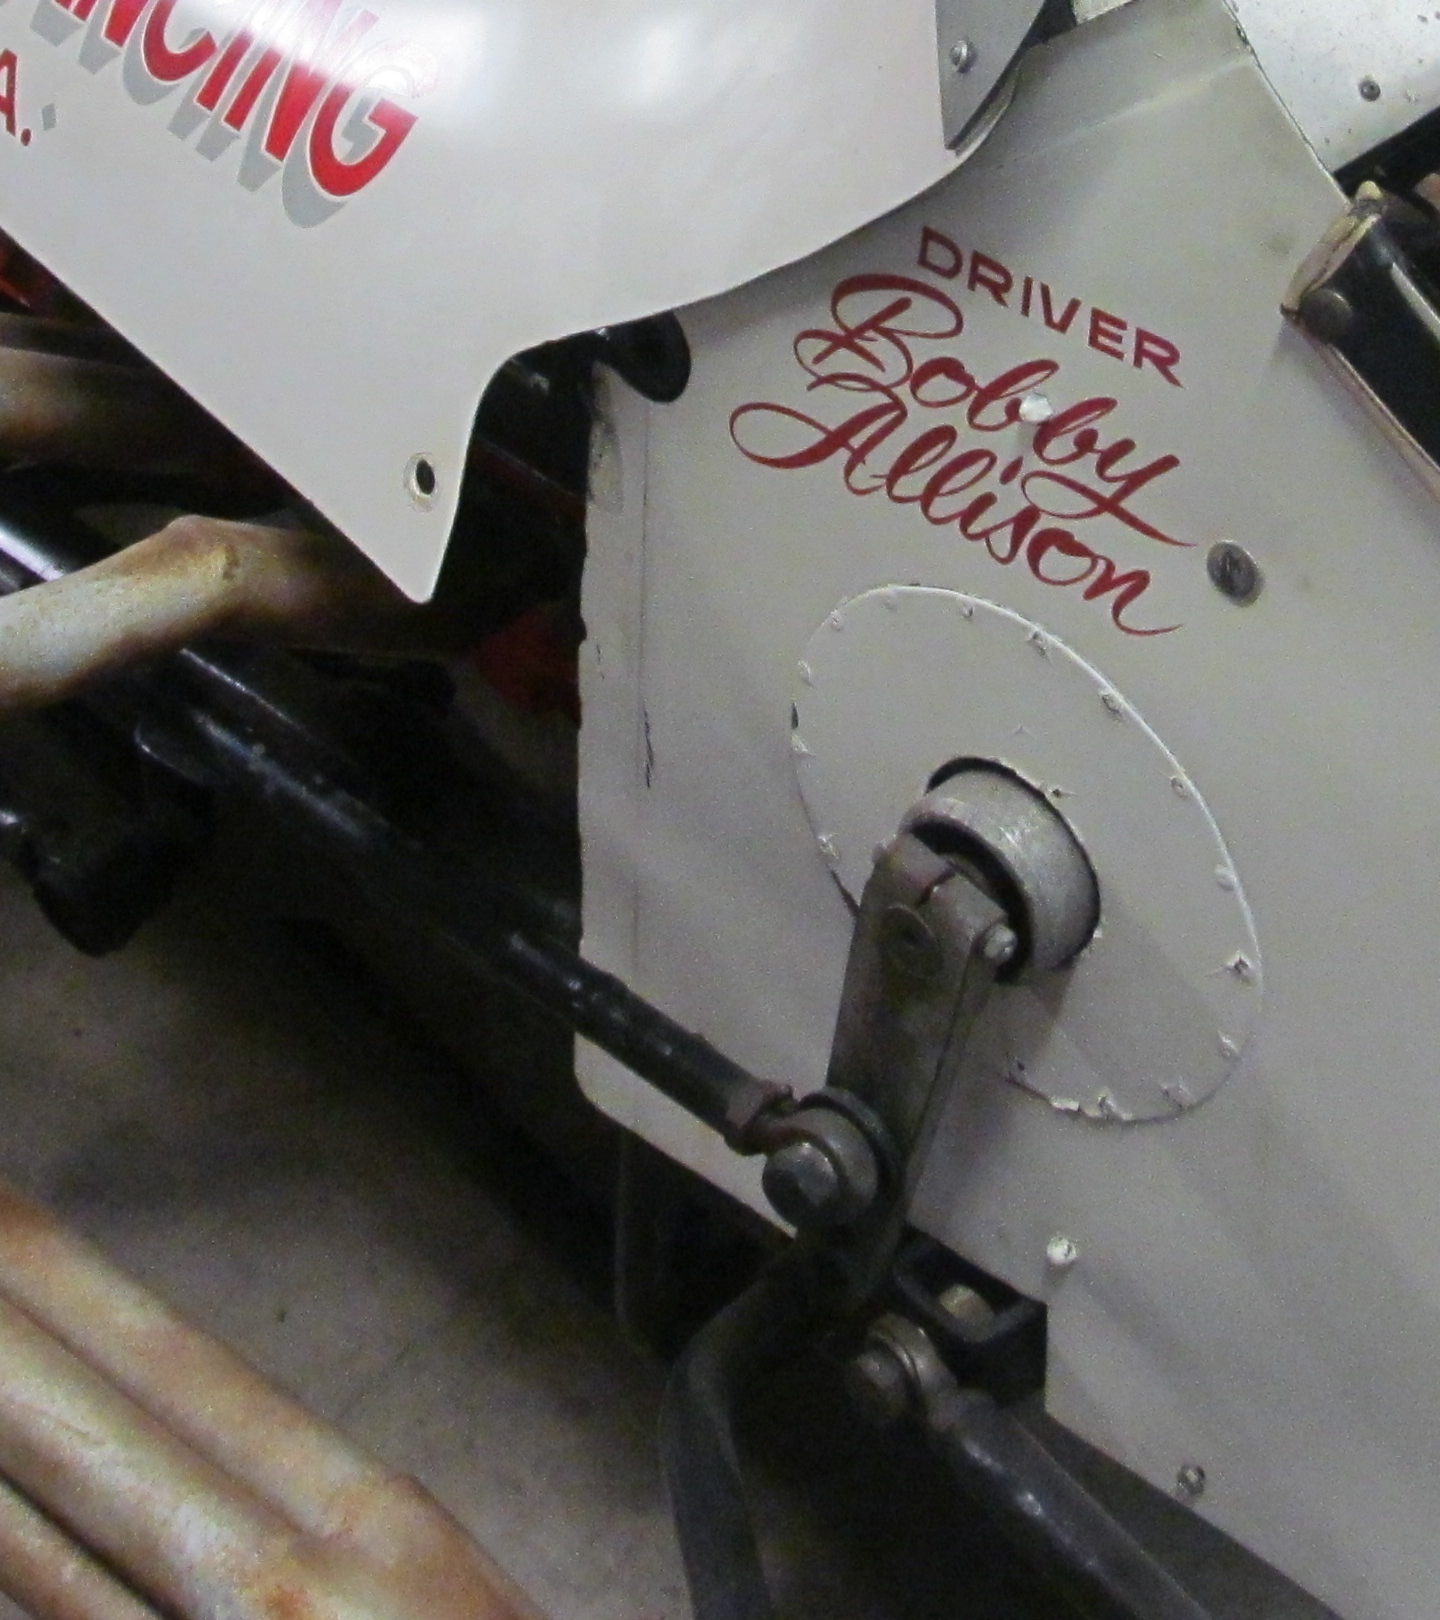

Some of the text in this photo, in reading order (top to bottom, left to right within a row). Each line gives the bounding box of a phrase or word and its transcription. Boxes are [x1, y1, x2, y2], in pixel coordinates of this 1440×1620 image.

[792, 272, 1198, 547] Bobby
[915, 225, 1185, 390] DRIVER
[728, 371, 1184, 637] Allison
